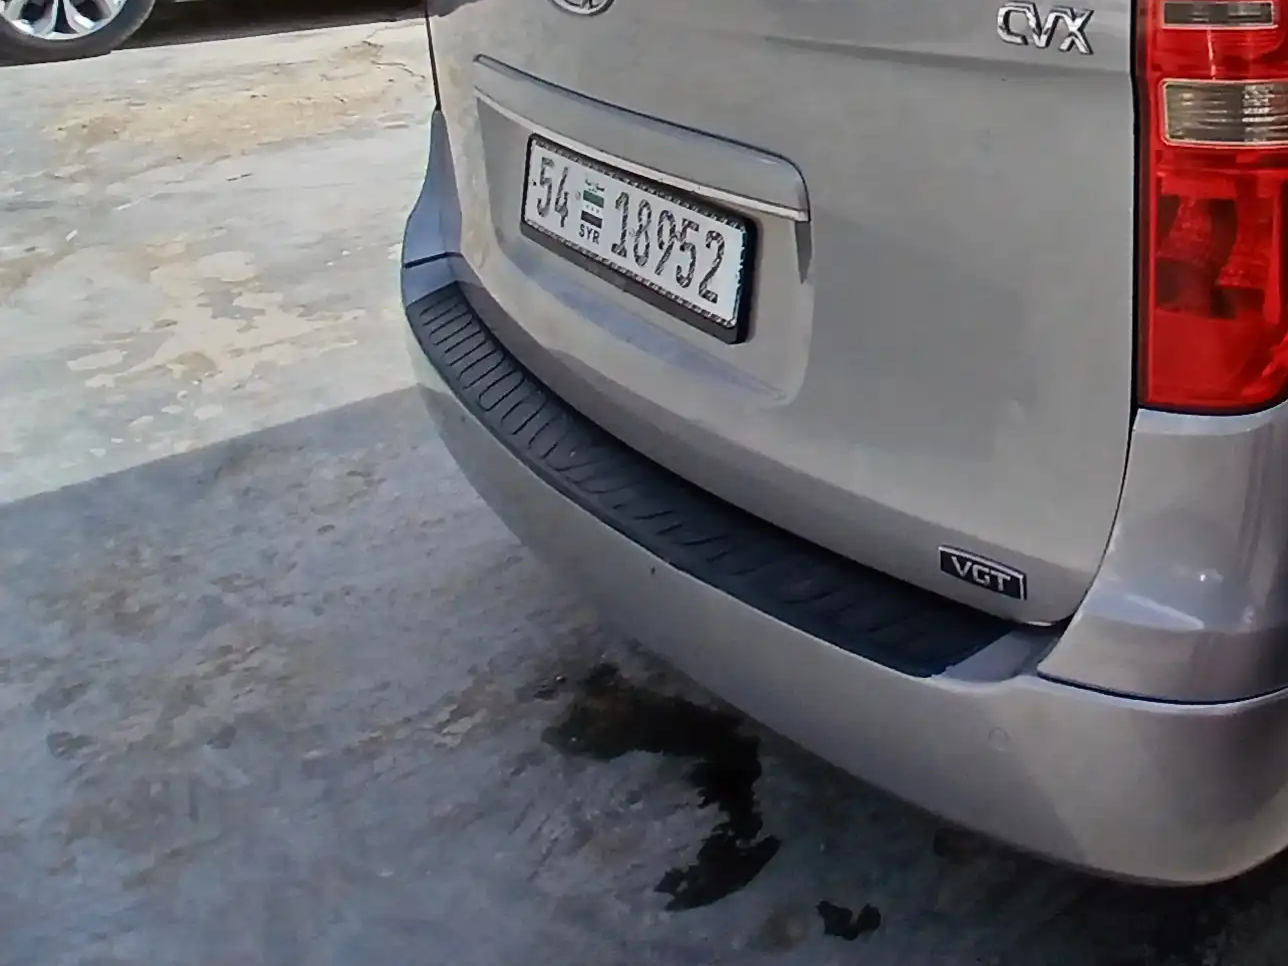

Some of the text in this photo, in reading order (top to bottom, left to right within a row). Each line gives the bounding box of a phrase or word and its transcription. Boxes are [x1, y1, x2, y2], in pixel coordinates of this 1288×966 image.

[996, 0, 1095, 55] CVX
[535, 156, 726, 305] 54 SYR 18952
[950, 555, 1012, 592] VGT
